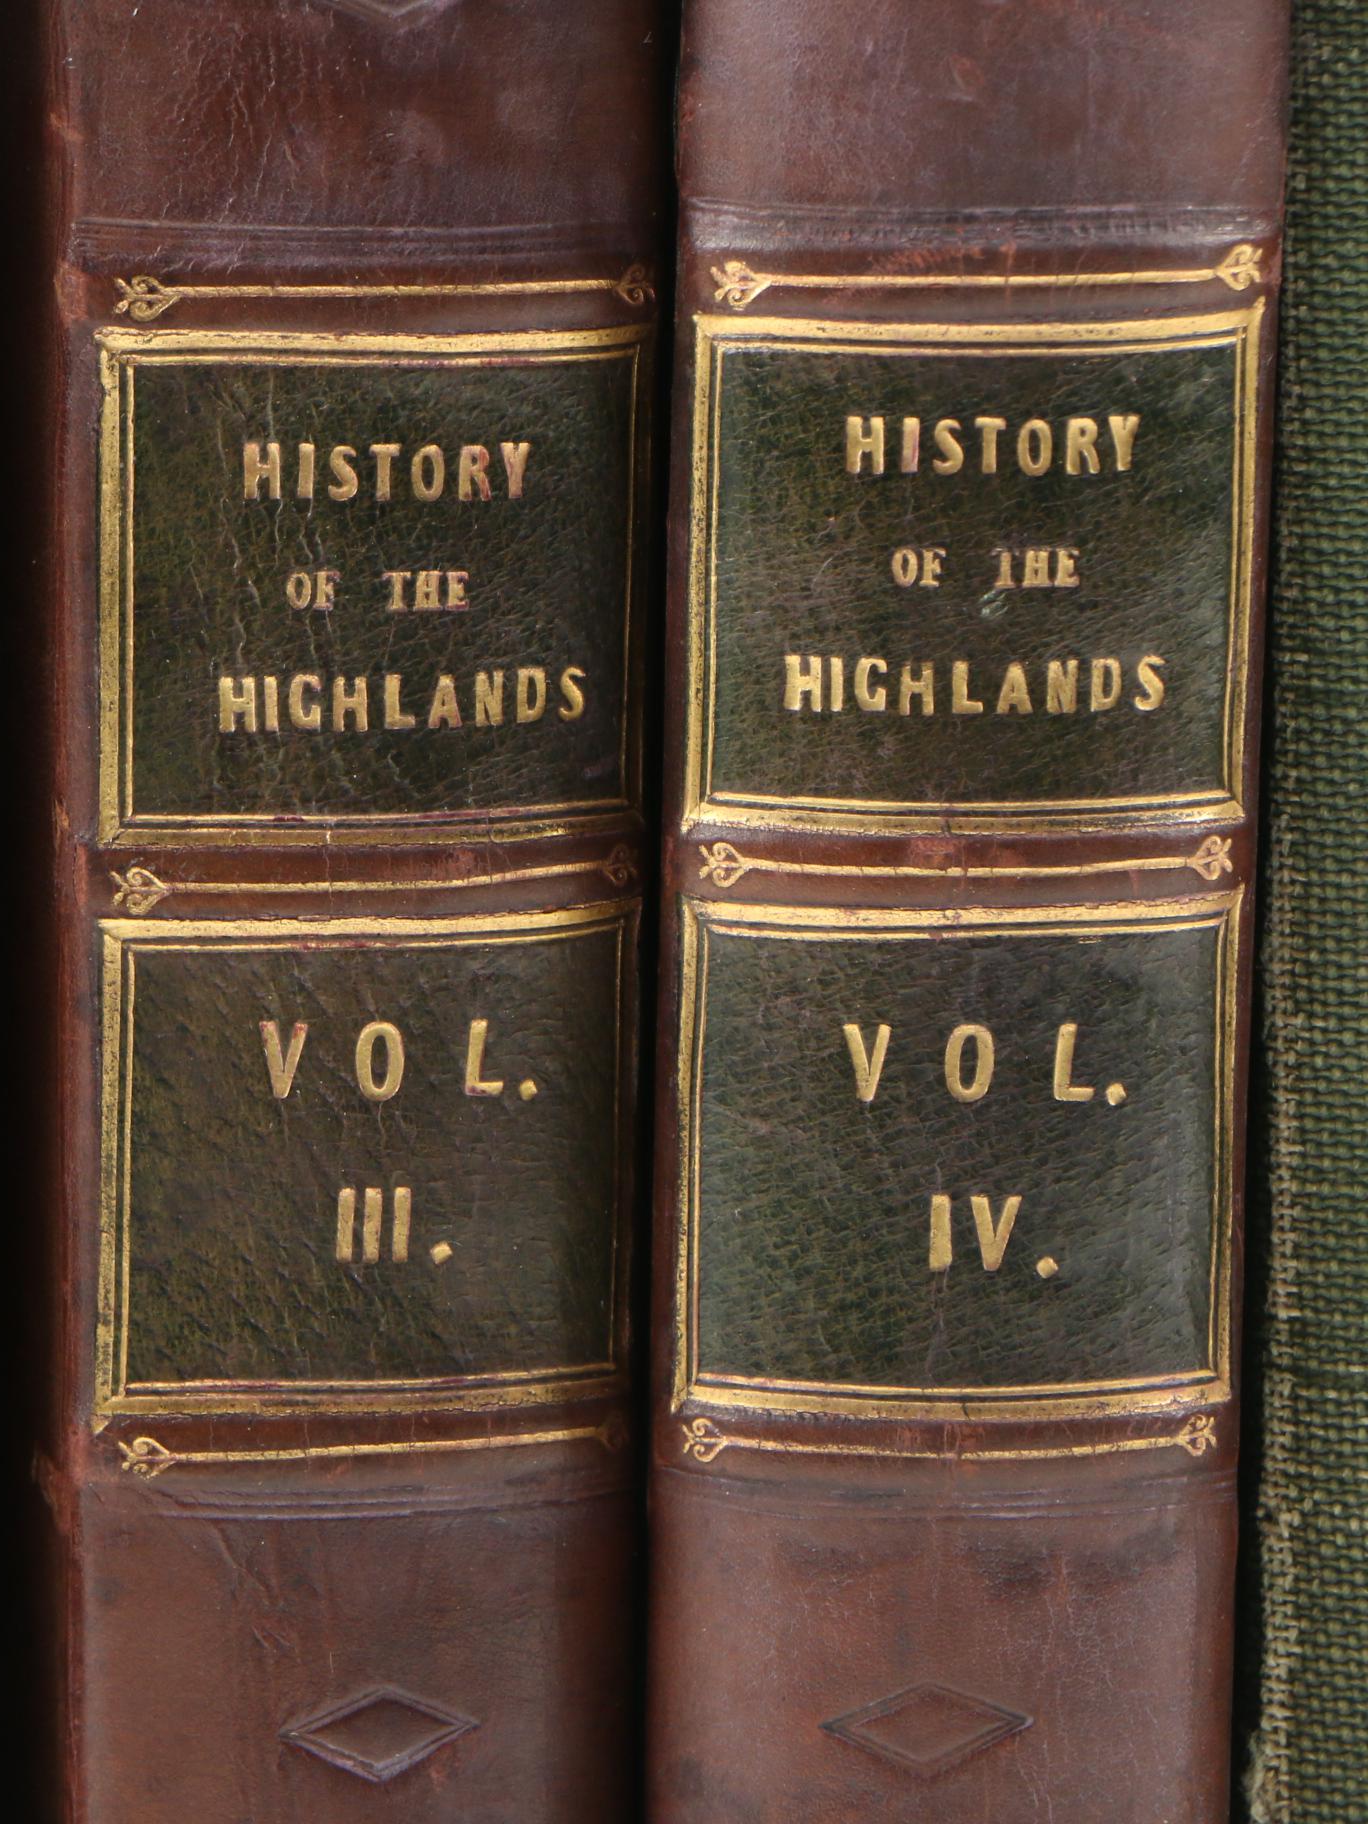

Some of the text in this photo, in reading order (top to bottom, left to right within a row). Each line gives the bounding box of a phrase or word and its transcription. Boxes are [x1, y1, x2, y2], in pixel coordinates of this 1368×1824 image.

[242, 440, 531, 502] HISTORY
[845, 413, 1140, 476] HISTORY
[285, 569, 469, 611] OF THE
[891, 547, 1080, 588] OF THE
[218, 667, 586, 733] HIGHLANDS
[783, 651, 1166, 716] HIGHLANDS
[258, 1018, 538, 1101] VOL.
[842, 1022, 1127, 1106] VOL.
[335, 1186, 453, 1265] III.
[928, 1193, 1059, 1279] IV.
